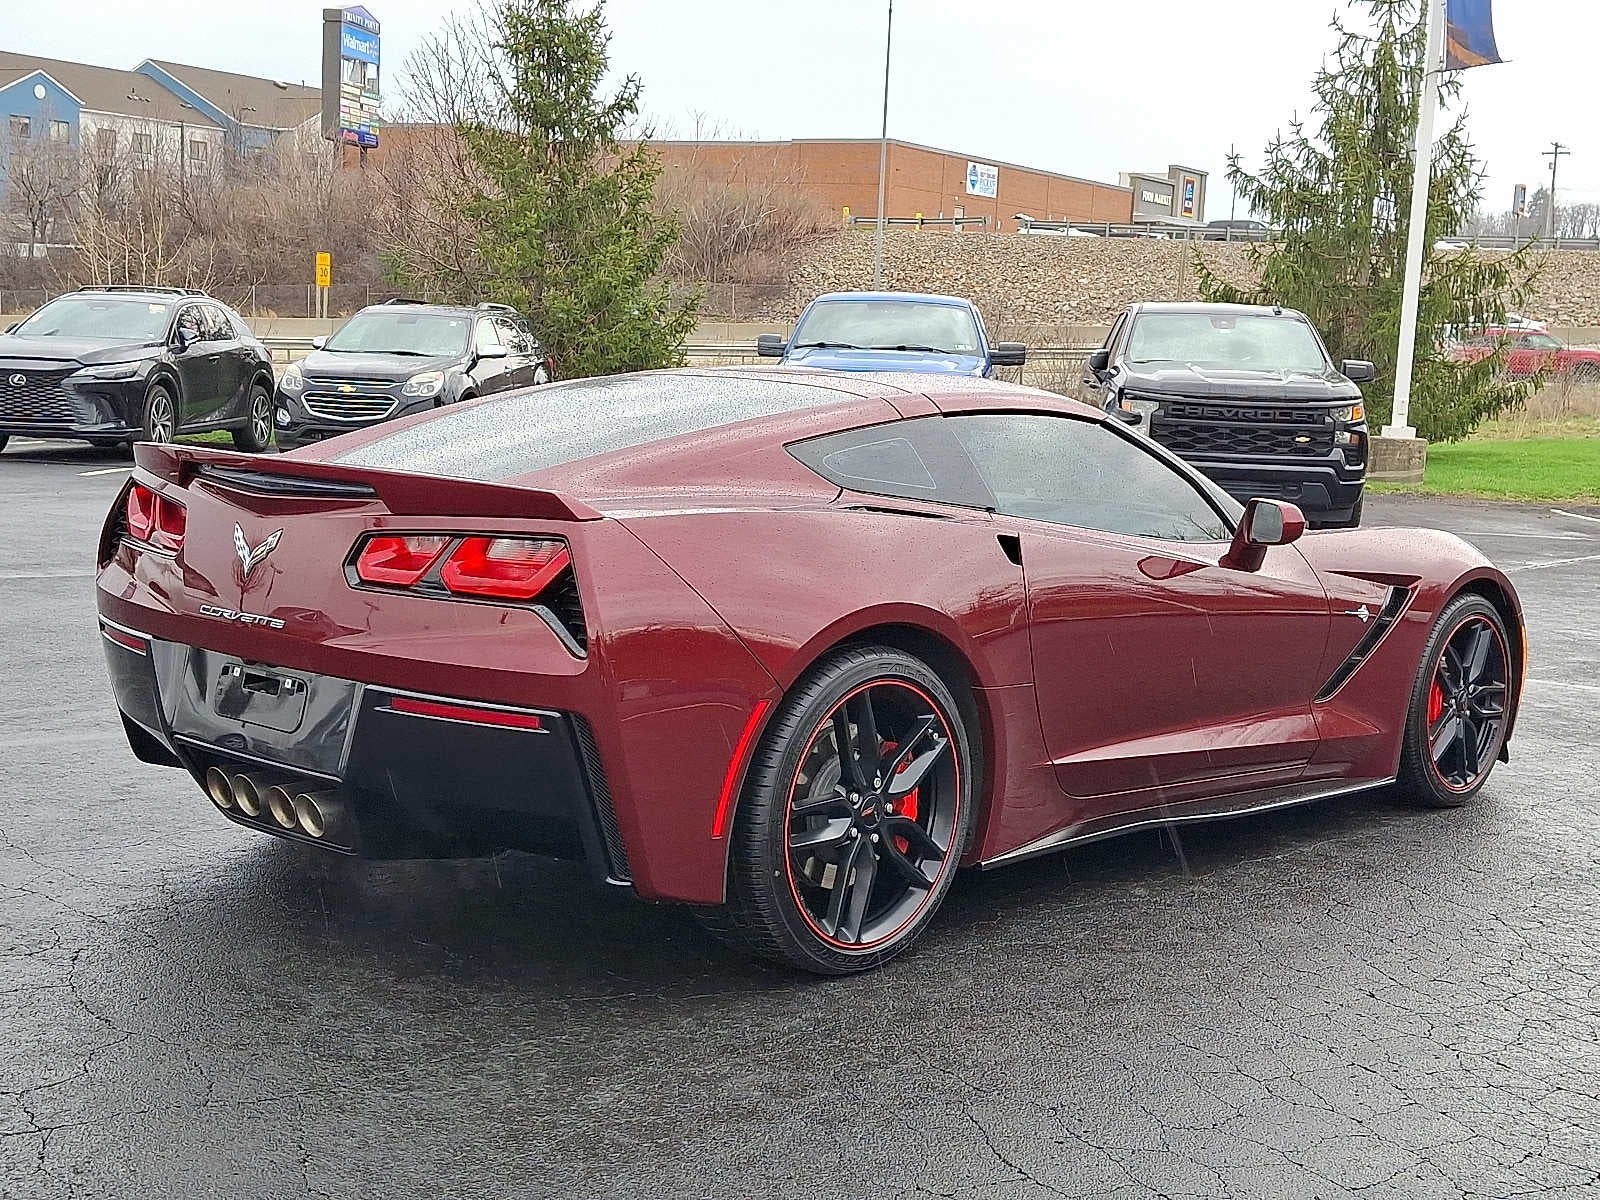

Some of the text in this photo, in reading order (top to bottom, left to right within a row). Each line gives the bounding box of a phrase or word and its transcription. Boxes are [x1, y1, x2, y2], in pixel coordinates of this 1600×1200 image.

[343, 32, 370, 55] Walmart
[1142, 190, 1154, 203] FOOD
[1154, 193, 1172, 206] MARKET
[1165, 405, 1325, 424] CHEVROLET
[199, 604, 286, 629] CORVETTE
